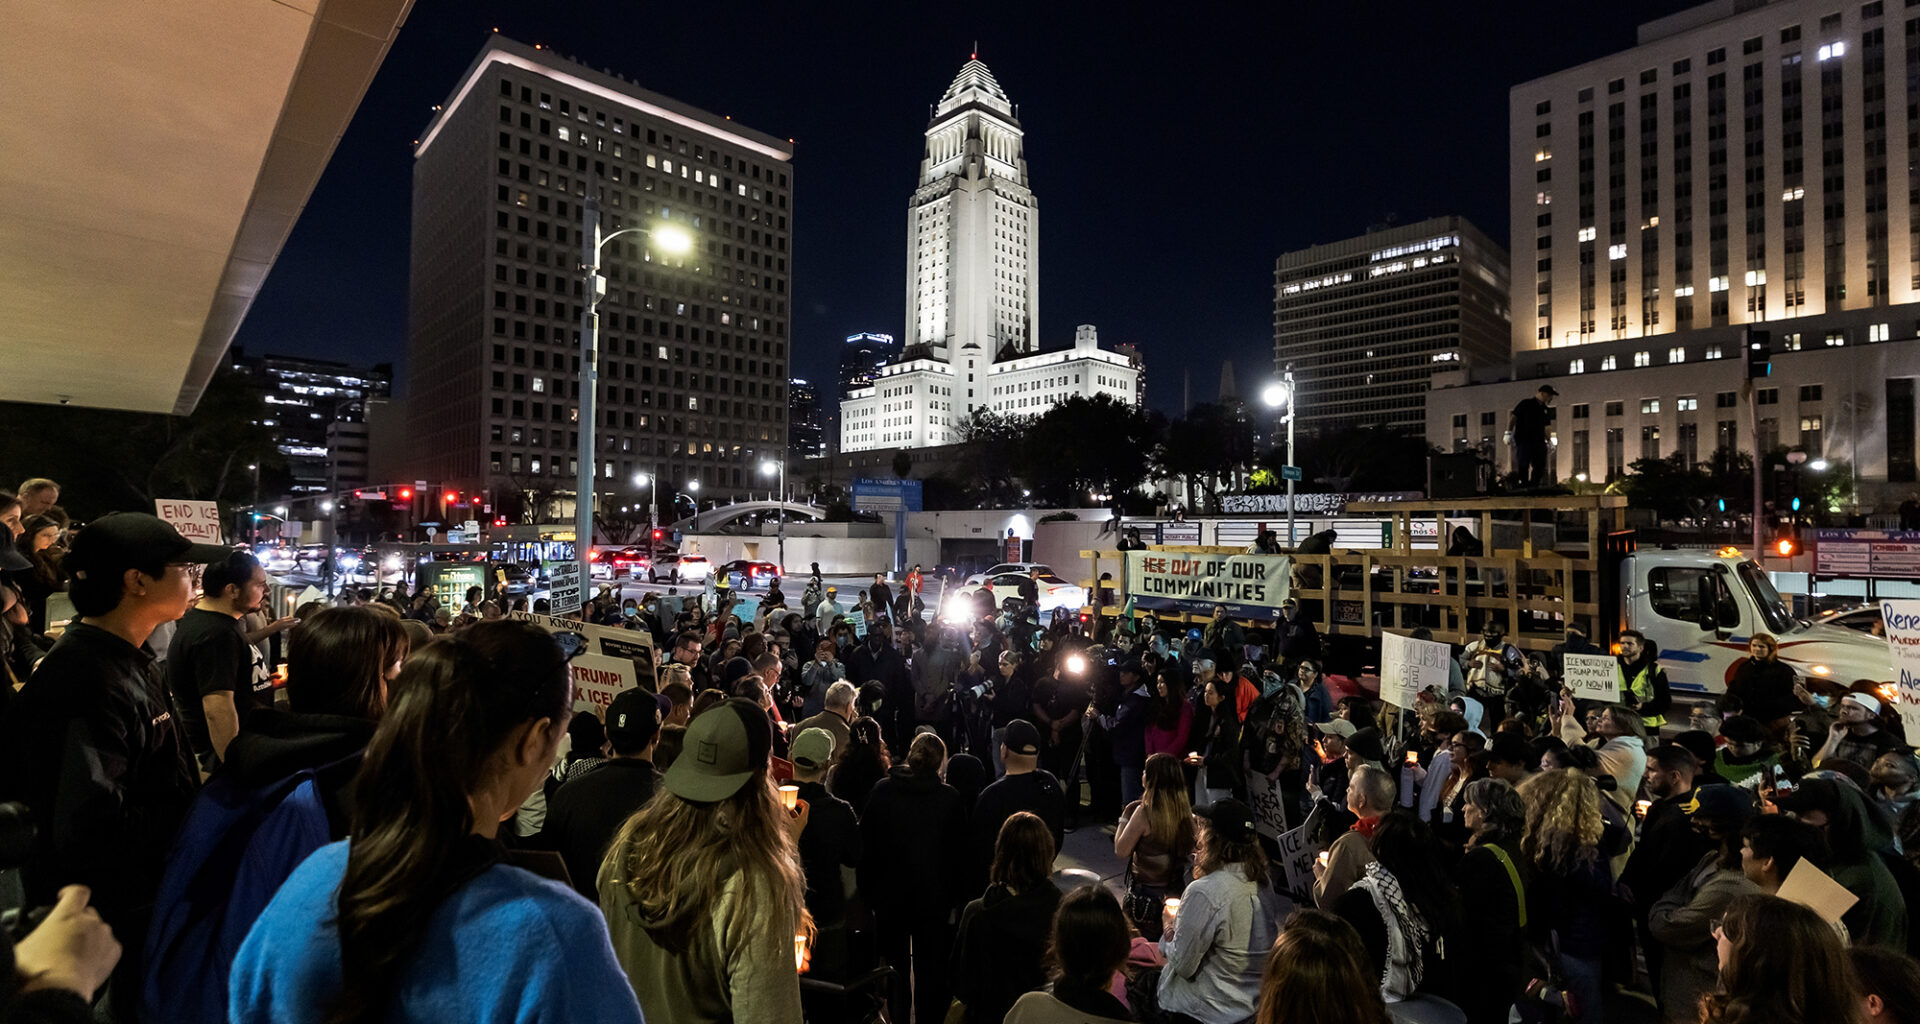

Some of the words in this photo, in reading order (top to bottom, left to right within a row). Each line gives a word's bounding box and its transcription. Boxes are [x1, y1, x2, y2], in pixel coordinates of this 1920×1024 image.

[162, 504, 193, 518] END
[200, 506, 219, 520] ICE
[173, 522, 220, 543] RUTALITY
[1171, 559, 1202, 576] OUT
[1206, 561, 1226, 577] OF
[1232, 562, 1265, 580] OUR
[552, 587, 579, 598] STOP
[1144, 576, 1266, 601] COMMUNITIES
[516, 612, 540, 624] YOU
[549, 617, 584, 632] KNOW
[1384, 638, 1449, 670] ABOLISH
[1566, 657, 1579, 666] ICE
[573, 666, 623, 688] TRUMP!
[1393, 663, 1419, 688] ICE
[1567, 668, 1591, 676] TRUMP
[1280, 831, 1301, 856] ICE
